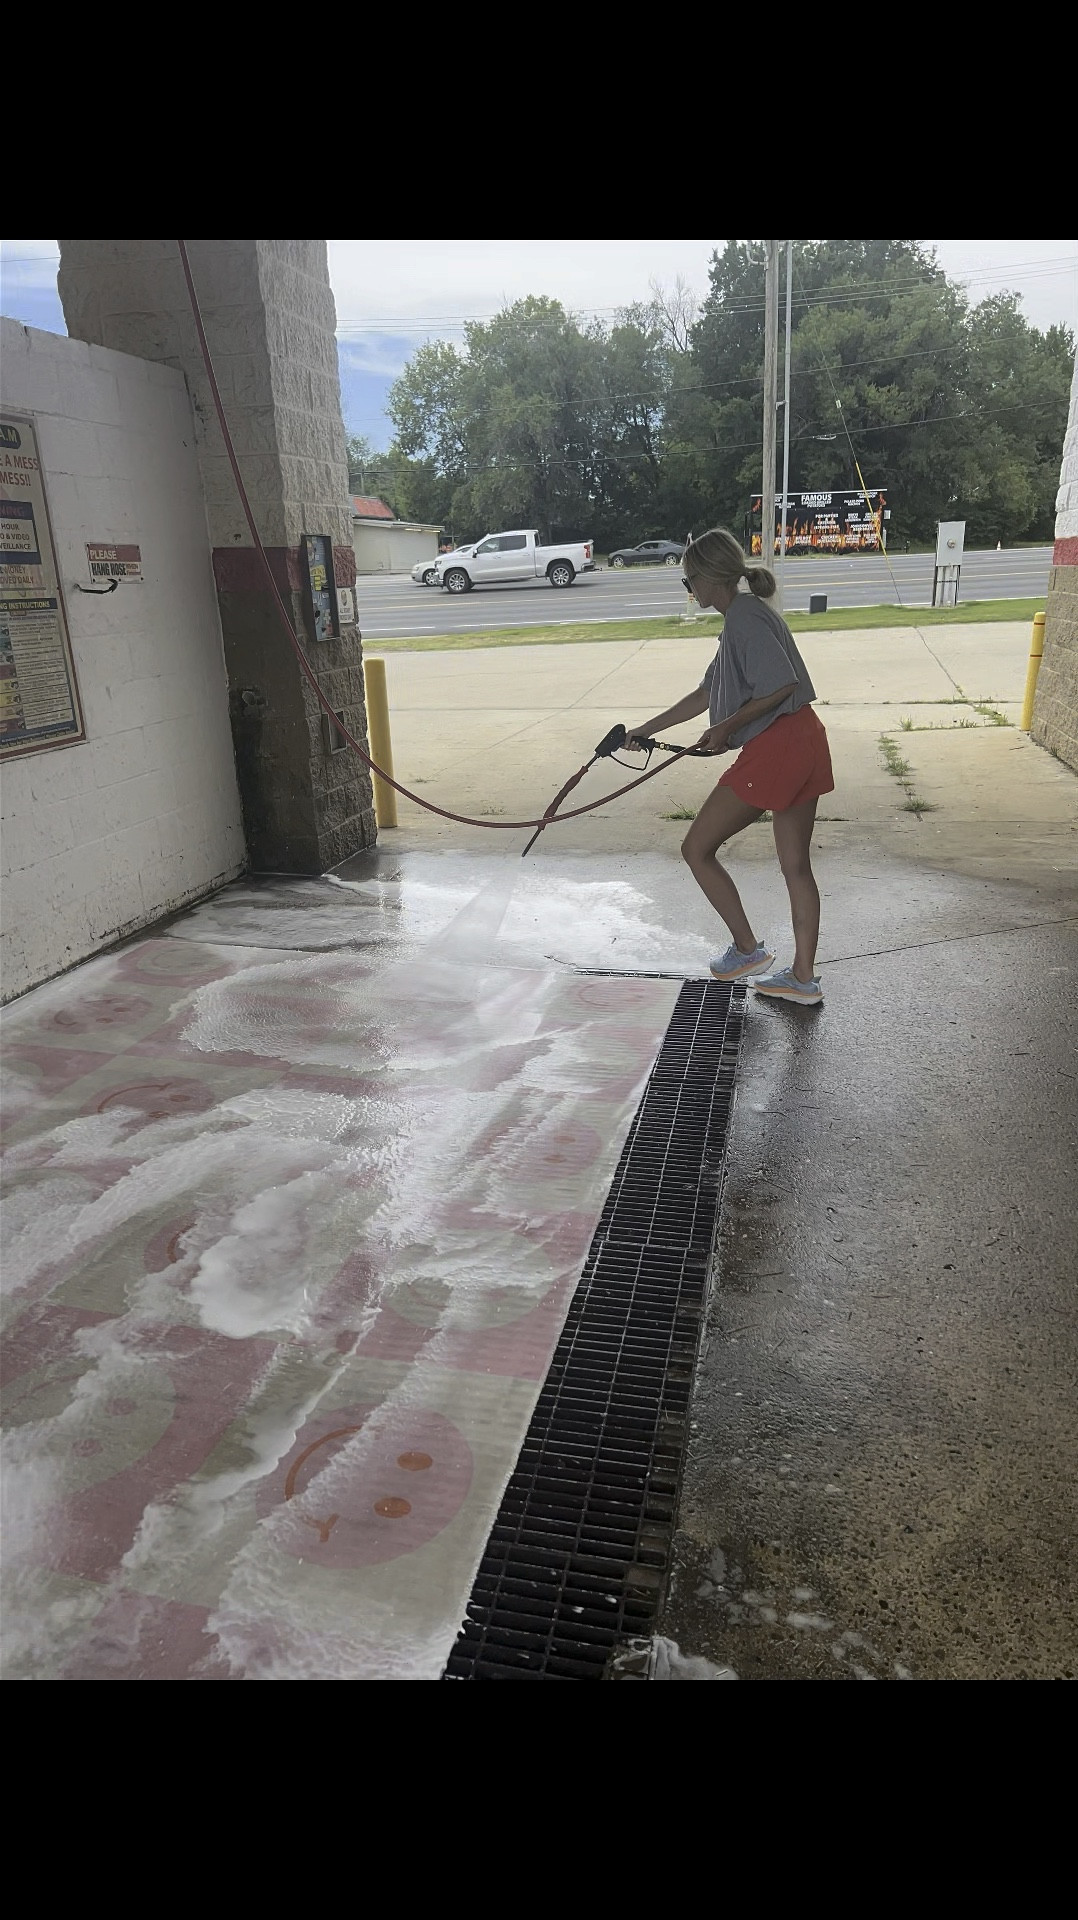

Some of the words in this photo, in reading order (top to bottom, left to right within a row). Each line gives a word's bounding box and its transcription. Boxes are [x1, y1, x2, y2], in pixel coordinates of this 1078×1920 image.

[5, 454, 12, 467] A
[13, 455, 40, 471] MESS
[801, 493, 832, 501] FAMOUS
[90, 550, 118, 560] PLEASE
[5, 566, 26, 574] MONEY
[91, 563, 110, 576] HANG
[110, 563, 127, 576] HOSE
[18, 576, 34, 584] DAILY
[8, 600, 50, 610] INSTRUCTIONS
